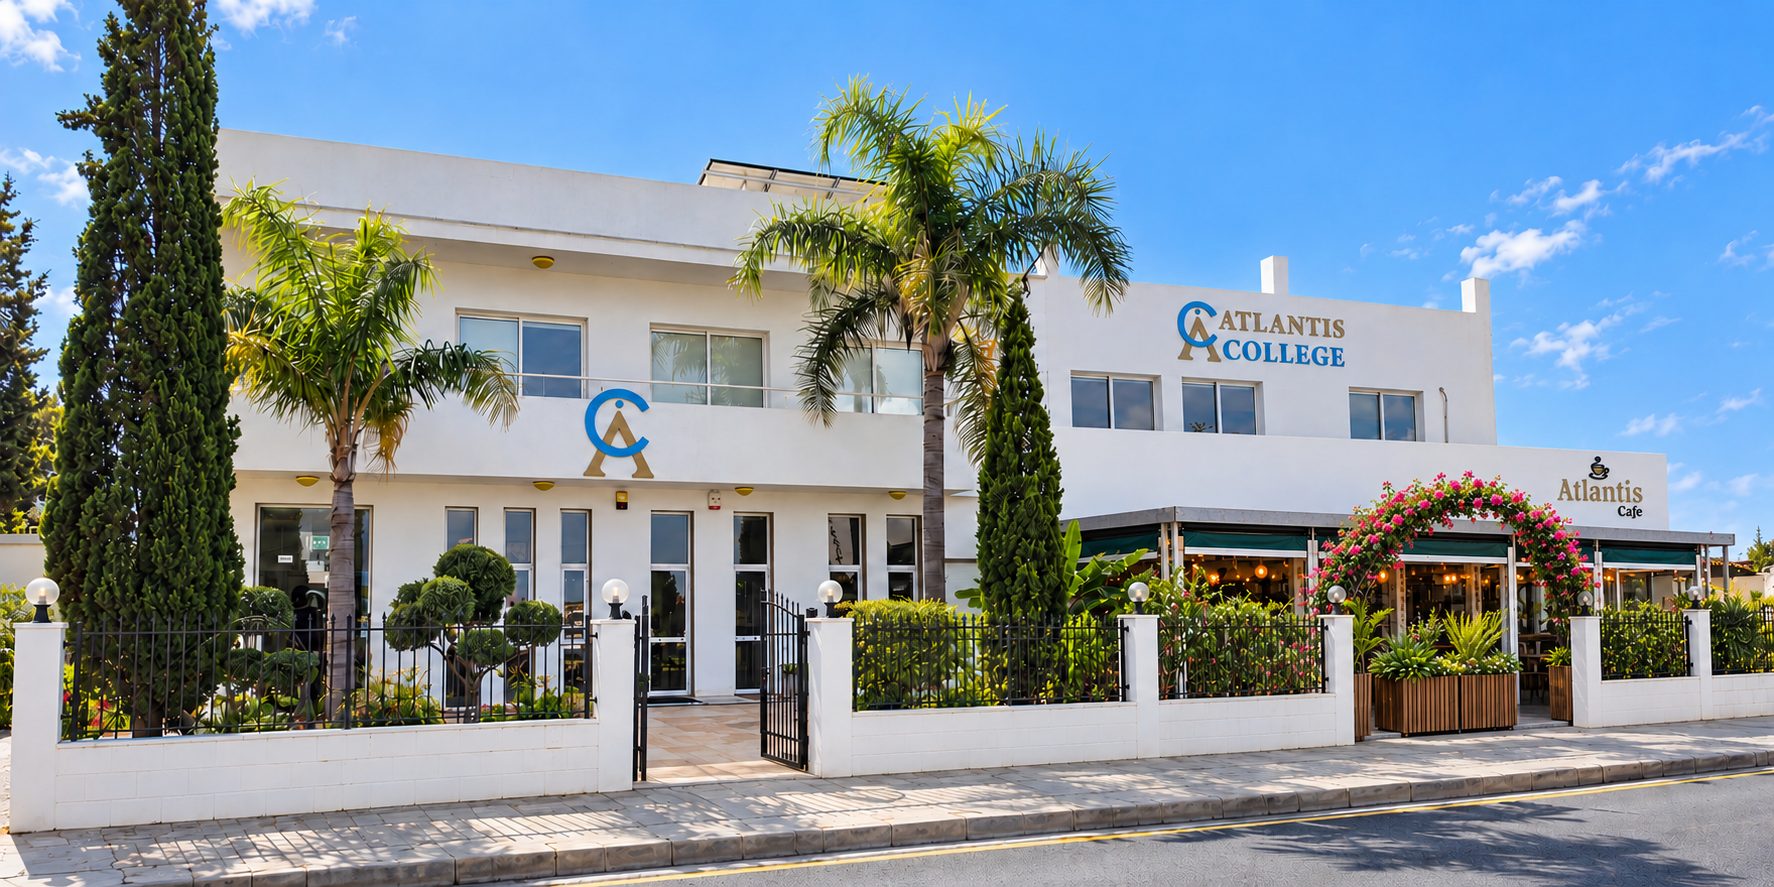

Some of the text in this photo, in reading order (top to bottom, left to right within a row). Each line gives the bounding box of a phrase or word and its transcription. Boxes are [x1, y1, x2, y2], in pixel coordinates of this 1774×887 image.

[1218, 310, 1345, 339] ATLANTIS
[1222, 339, 1345, 368] COLLEGE
[1557, 478, 1643, 504] Atlantis
[1617, 505, 1643, 519] Cafe
